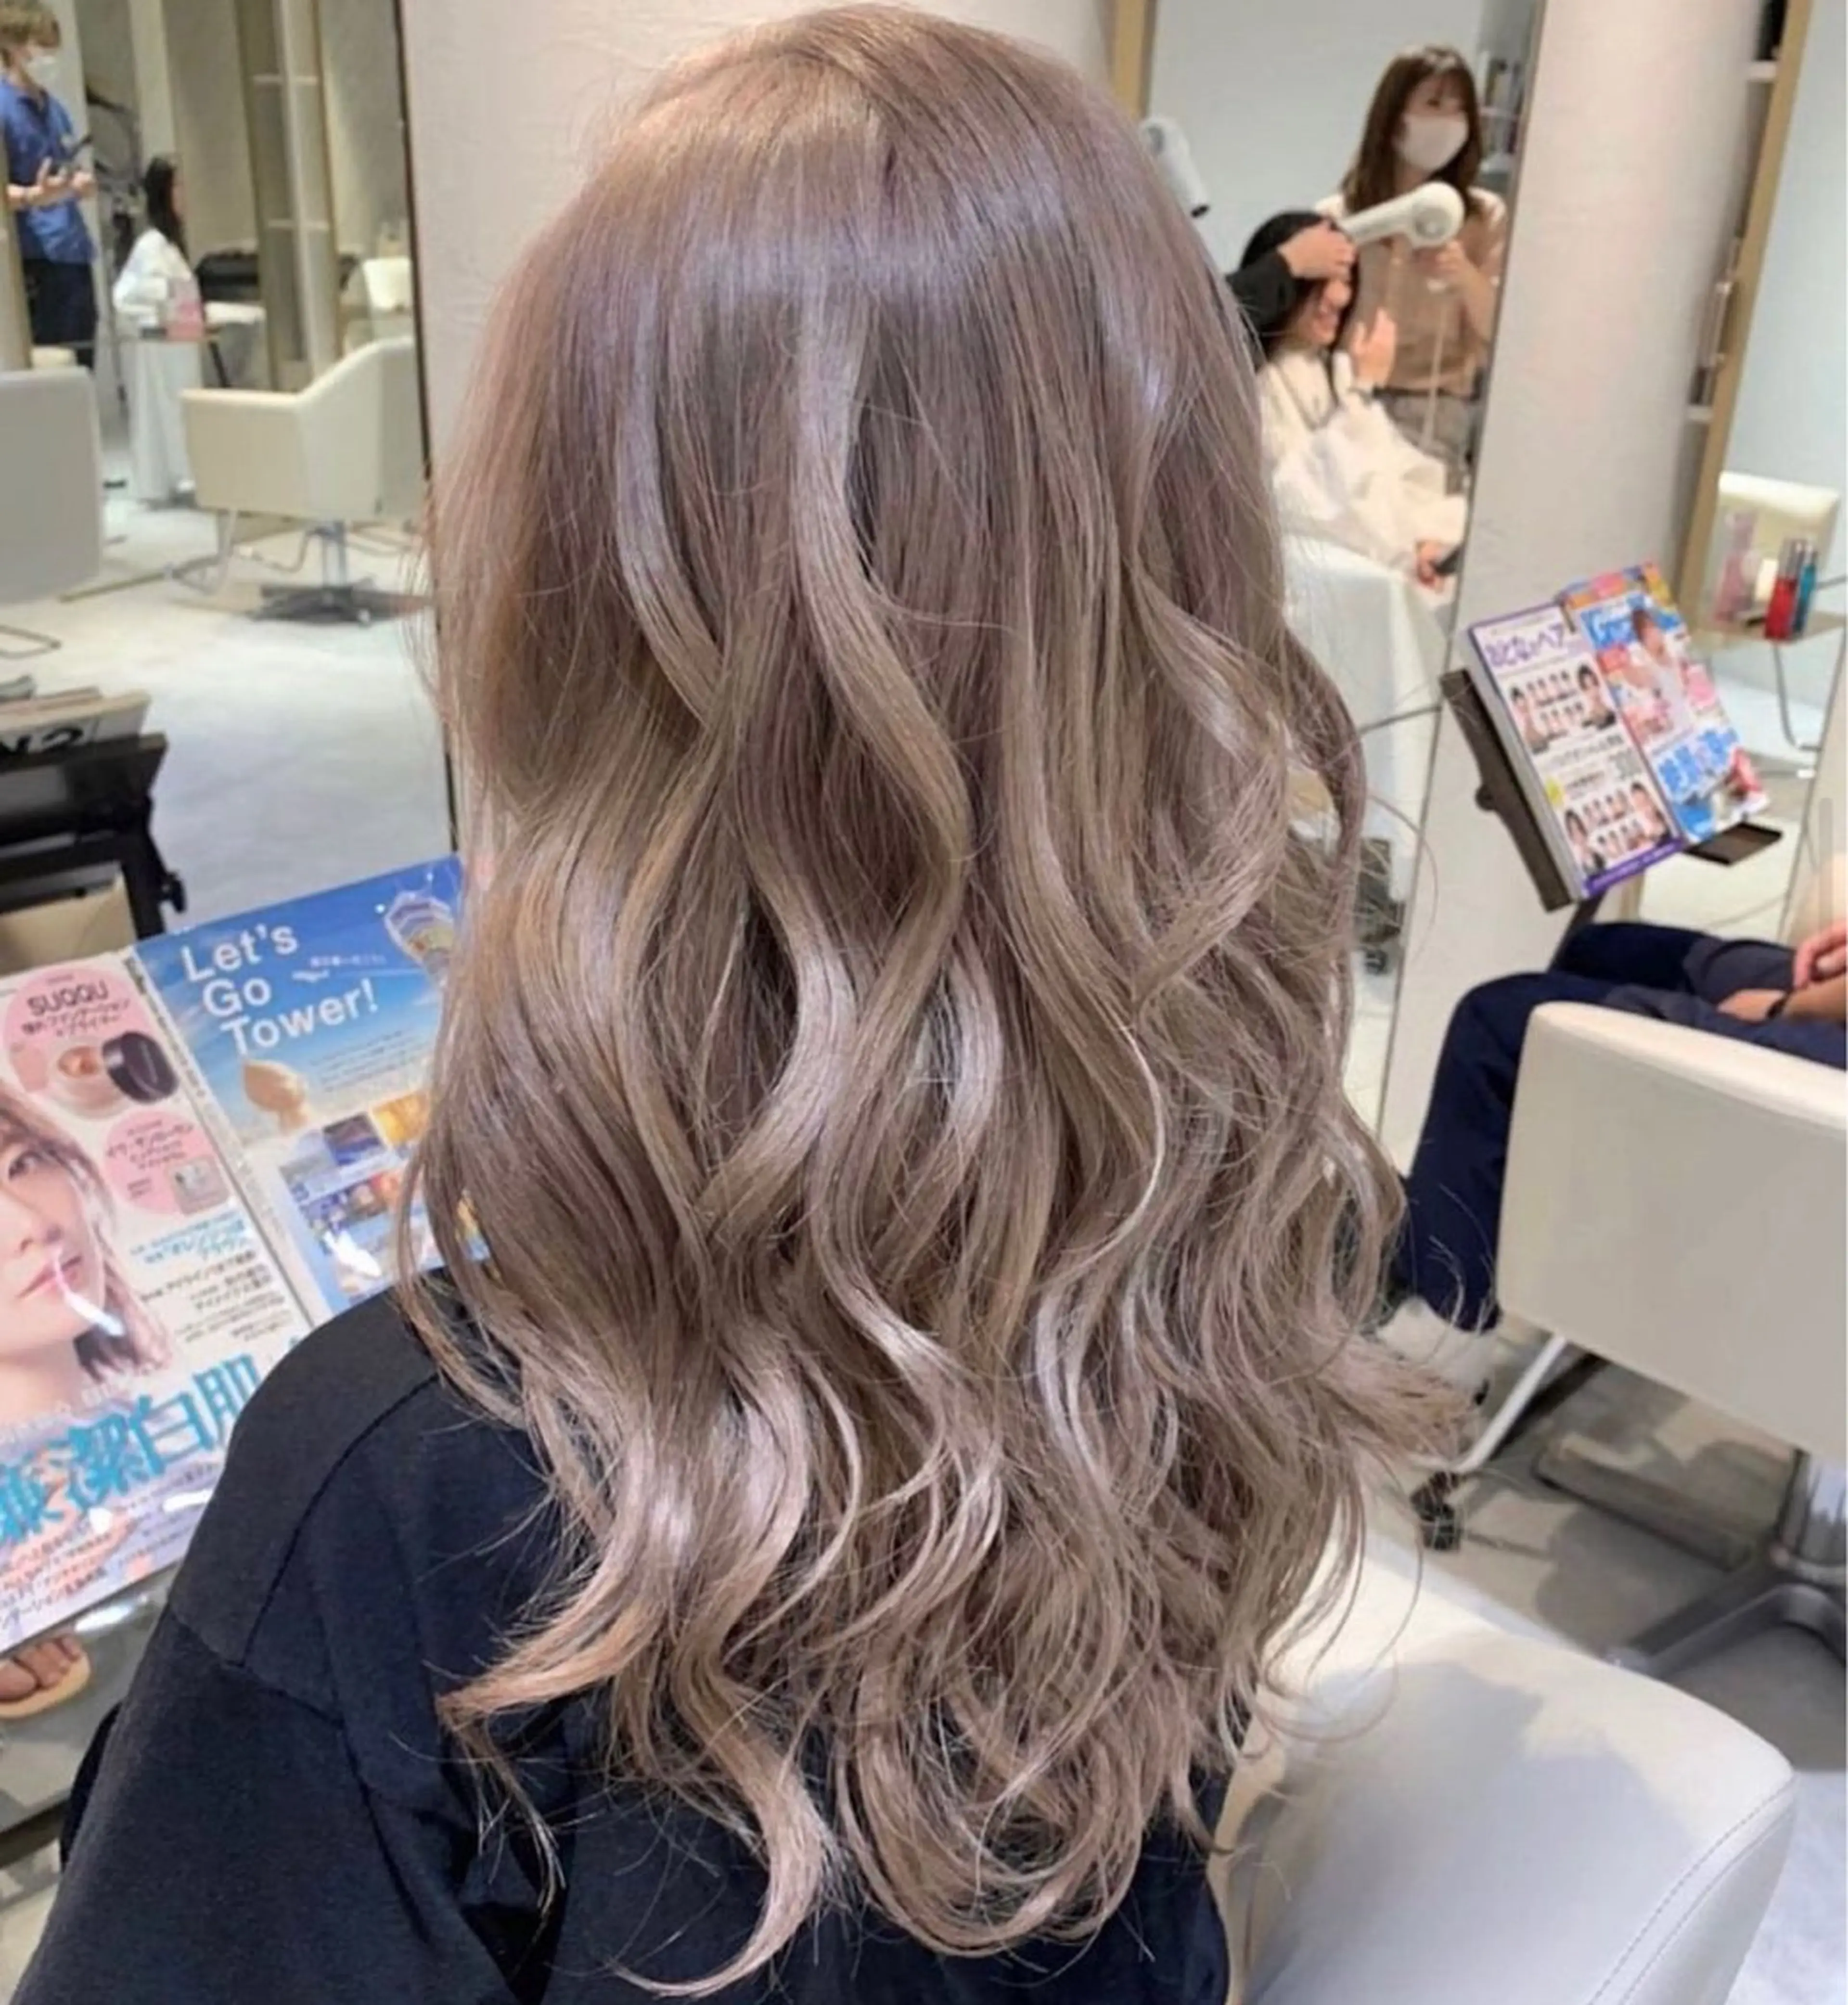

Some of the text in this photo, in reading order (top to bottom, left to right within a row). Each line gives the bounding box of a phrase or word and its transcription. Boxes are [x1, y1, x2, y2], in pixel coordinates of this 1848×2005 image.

[181, 923, 299, 982] Let's
[27, 978, 109, 1016] SUQQU
[203, 977, 272, 1015] Go
[220, 977, 378, 1054] Tower!
